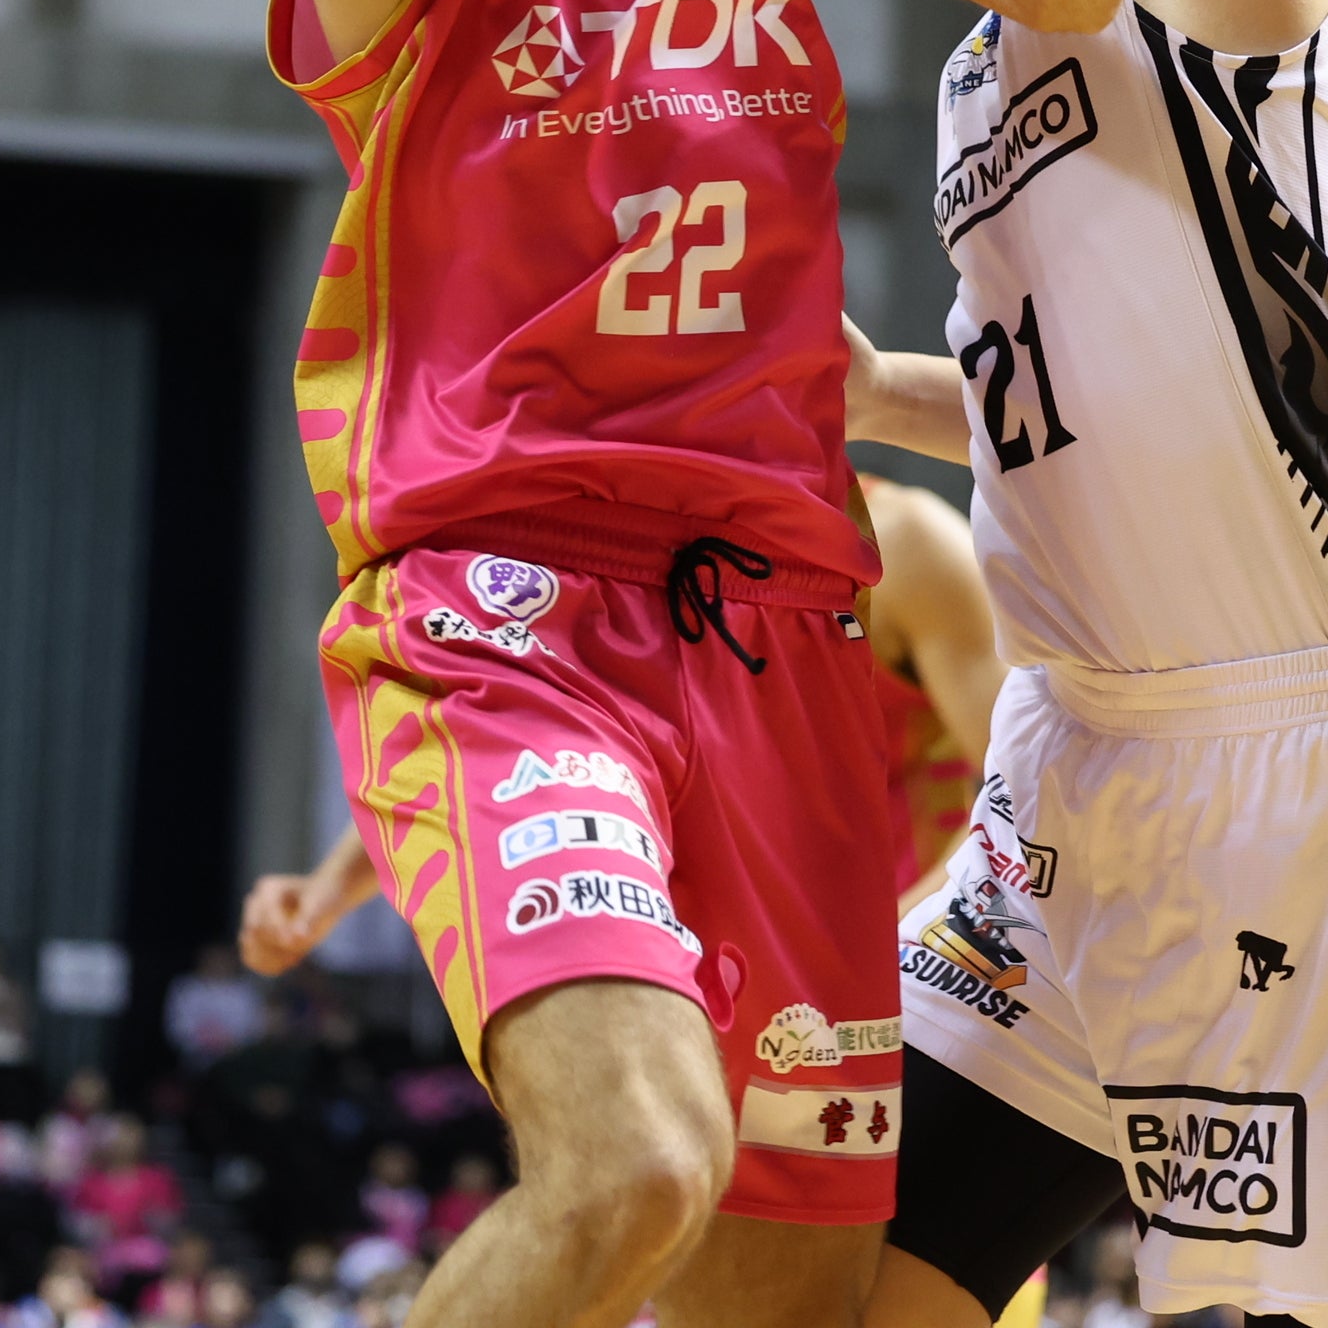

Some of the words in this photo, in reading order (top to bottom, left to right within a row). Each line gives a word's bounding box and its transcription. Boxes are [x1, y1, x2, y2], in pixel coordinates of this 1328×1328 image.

[499, 114, 527, 140] In
[538, 88, 725, 137] Eveything,
[722, 88, 812, 117] Bette
[596, 180, 748, 336] 22
[960, 293, 1078, 474] 21
[900, 949, 1030, 1029] SUNRISE
[1127, 1113, 1277, 1164] BANDAI
[1135, 1159, 1278, 1216] NAMCO
